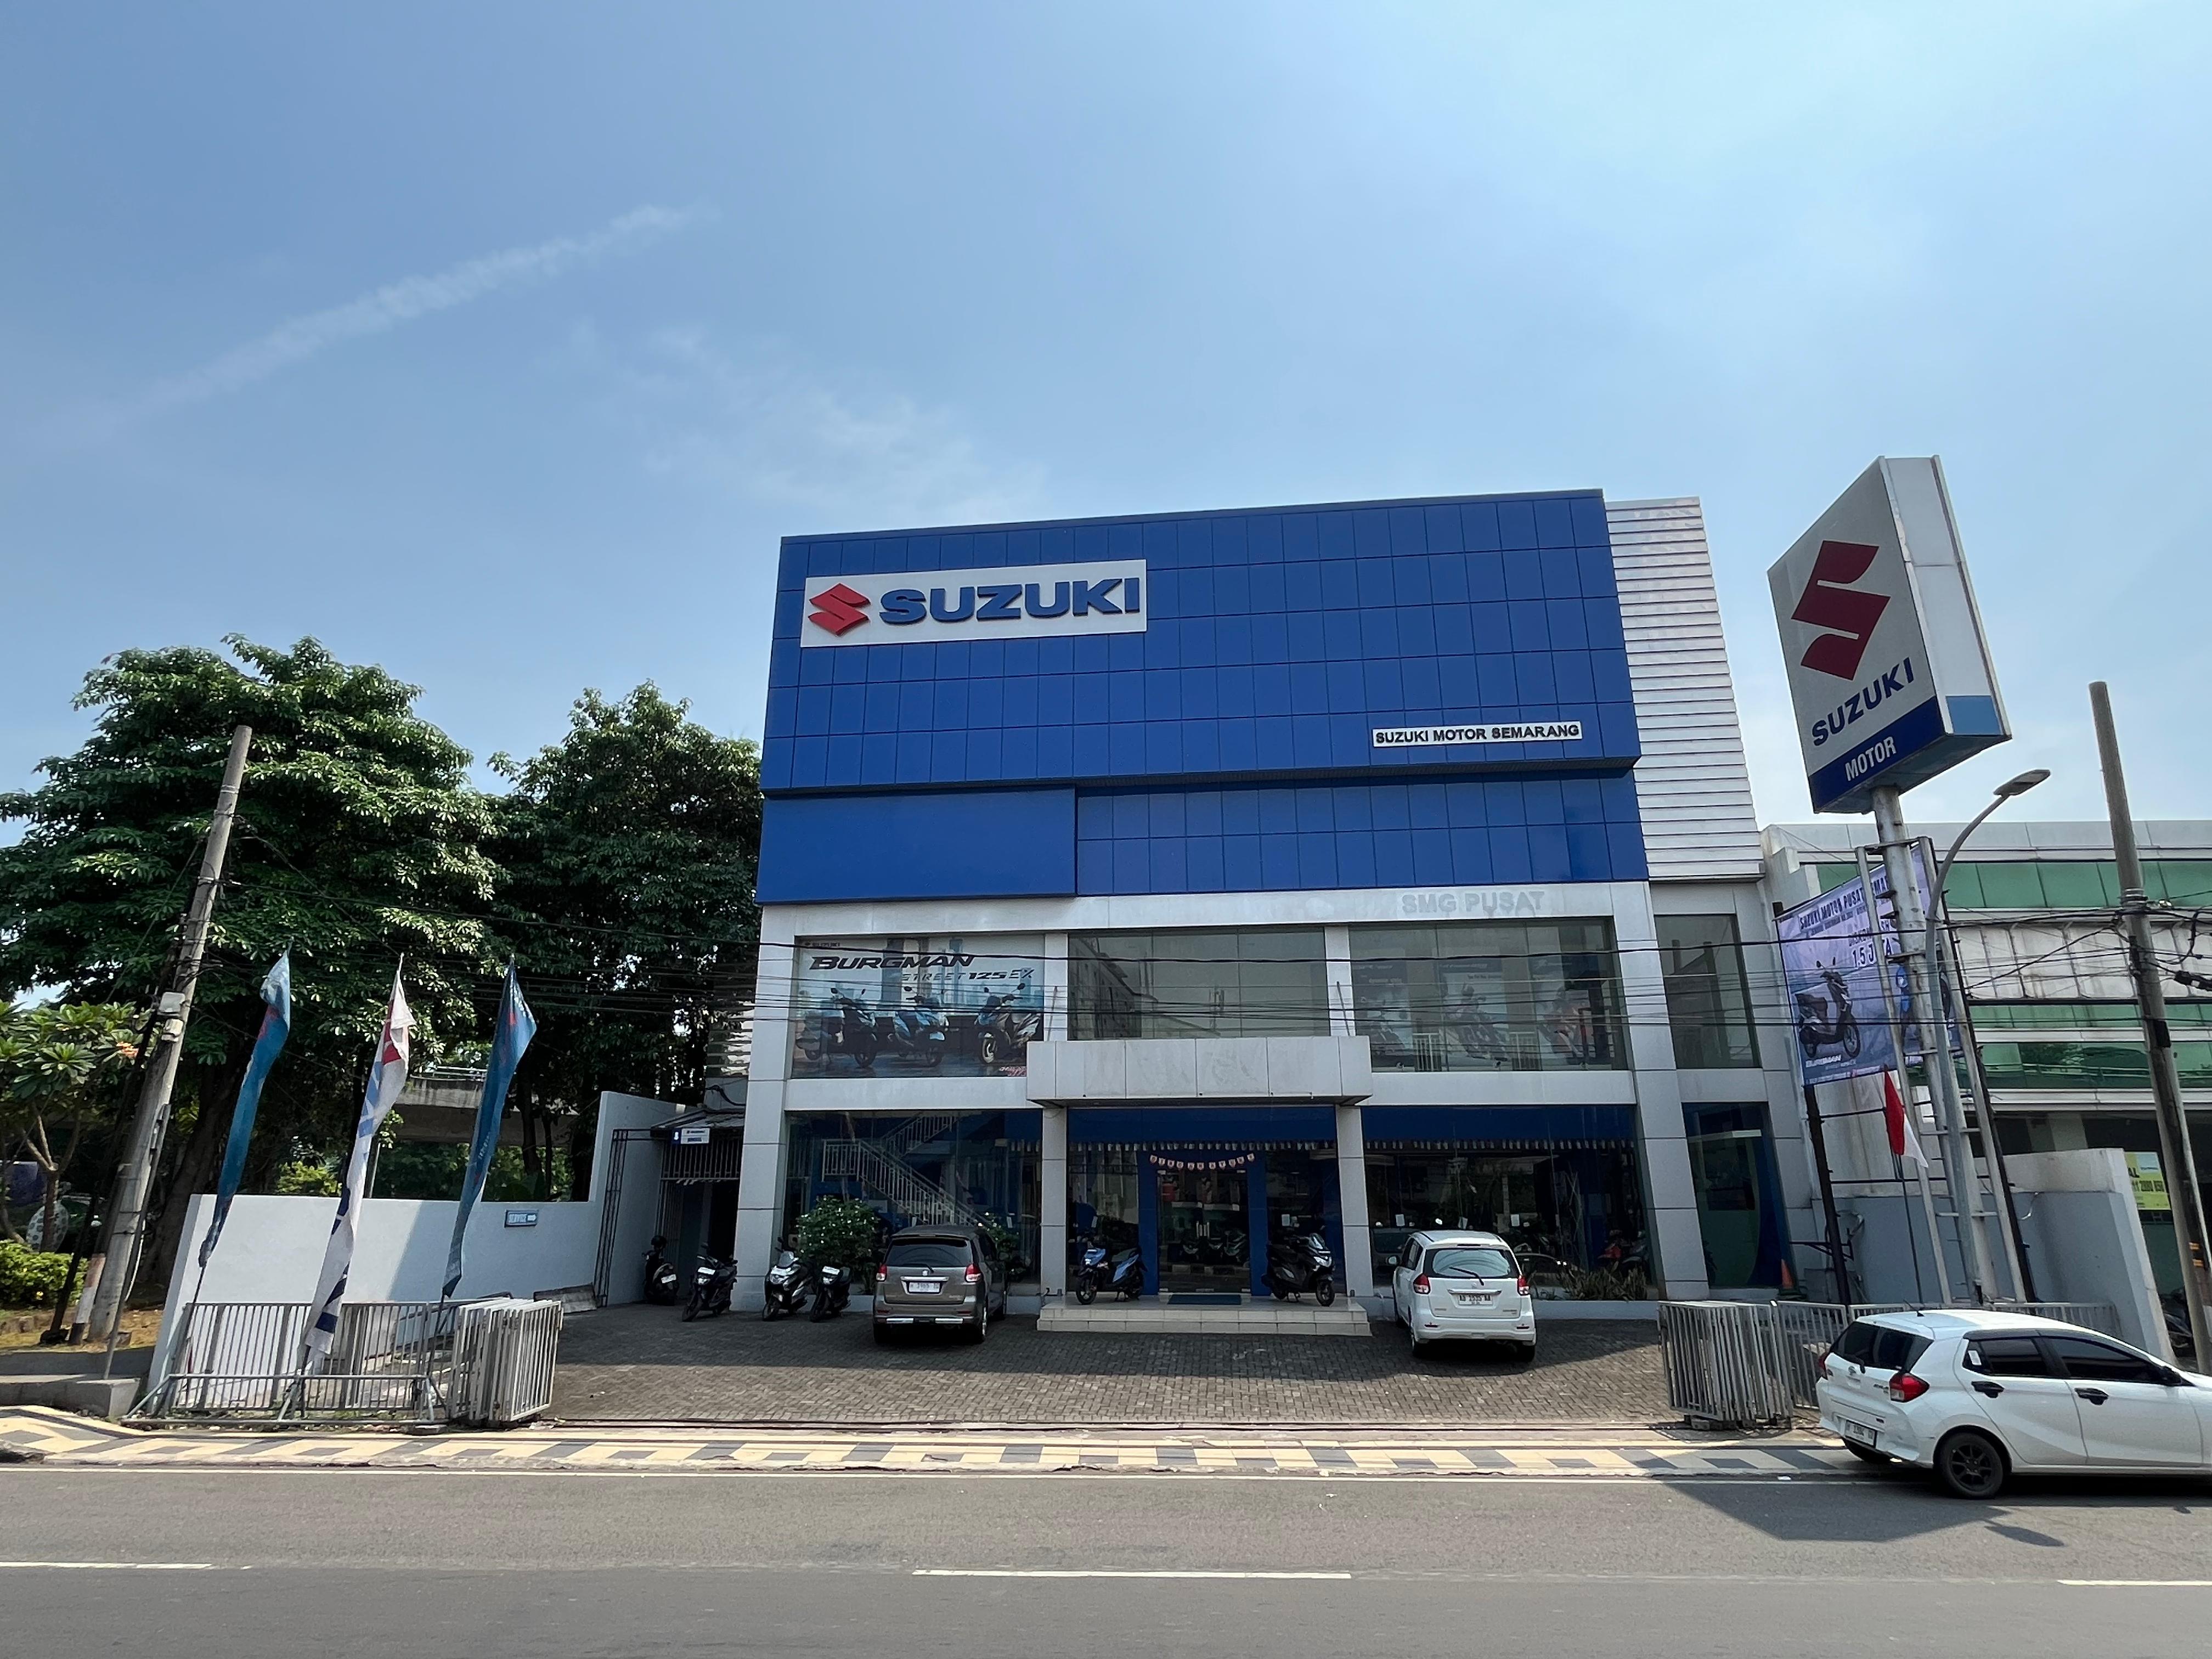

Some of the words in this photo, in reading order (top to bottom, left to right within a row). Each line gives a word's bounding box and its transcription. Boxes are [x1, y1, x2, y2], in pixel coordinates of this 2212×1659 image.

[879, 578, 1140, 624] SUZUKI
[1812, 657, 1915, 747] SUZUKI
[1376, 730, 1429, 743] SUZUKI
[1433, 728, 1487, 742] MOTOR
[1492, 725, 1579, 740] SEMARANG
[1844, 736, 1897, 781] MOTOR
[1402, 893, 1457, 914] SMG
[1464, 891, 1545, 917] PUSAT
[1799, 907, 1821, 930] SUZUKI
[1820, 898, 1843, 921] MOTOR
[1843, 887, 1865, 909] PUSAT
[809, 956, 975, 970] BURGMAN
[901, 972, 966, 981] STREET
